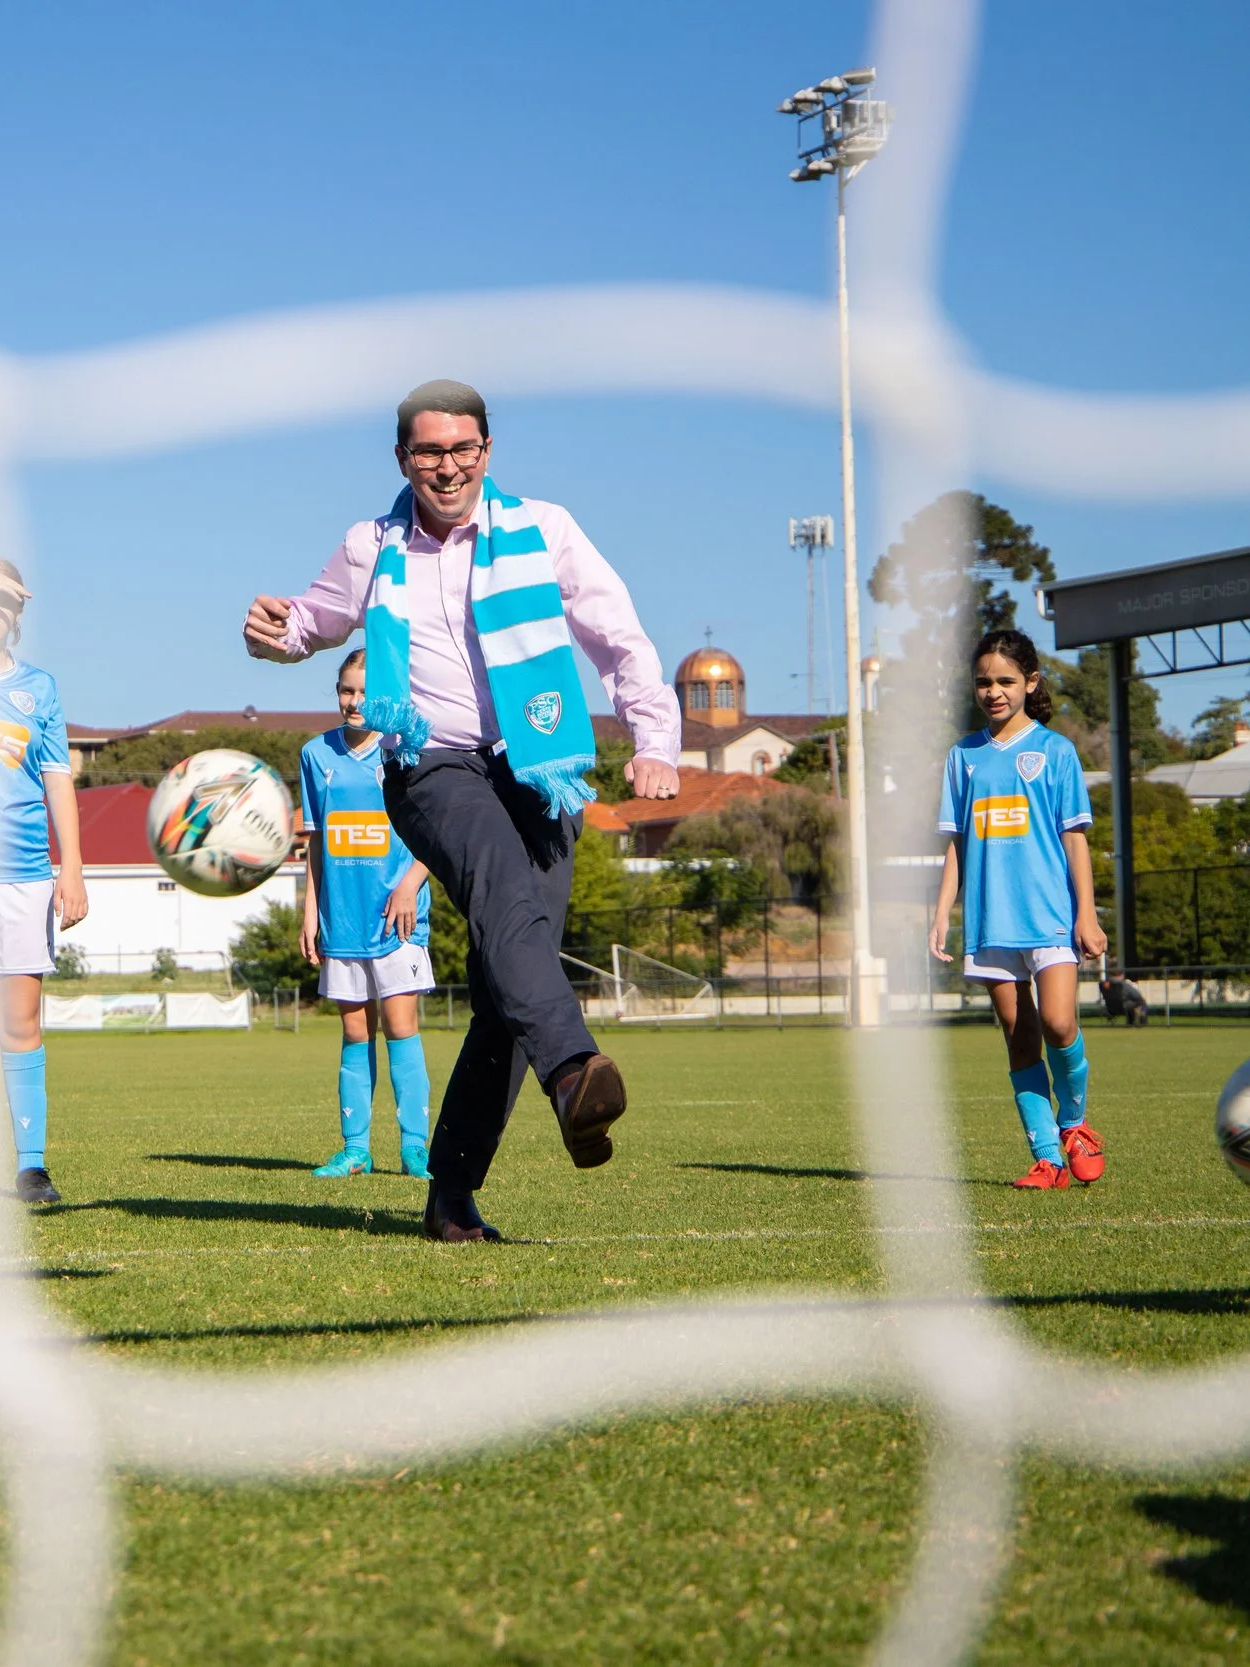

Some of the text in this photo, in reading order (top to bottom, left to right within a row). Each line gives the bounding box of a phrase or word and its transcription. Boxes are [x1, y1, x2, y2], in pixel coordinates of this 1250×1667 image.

[1118, 578, 1250, 614] MAJOR SPONSO
[974, 806, 1029, 829] TES
[327, 824, 390, 845] TES
